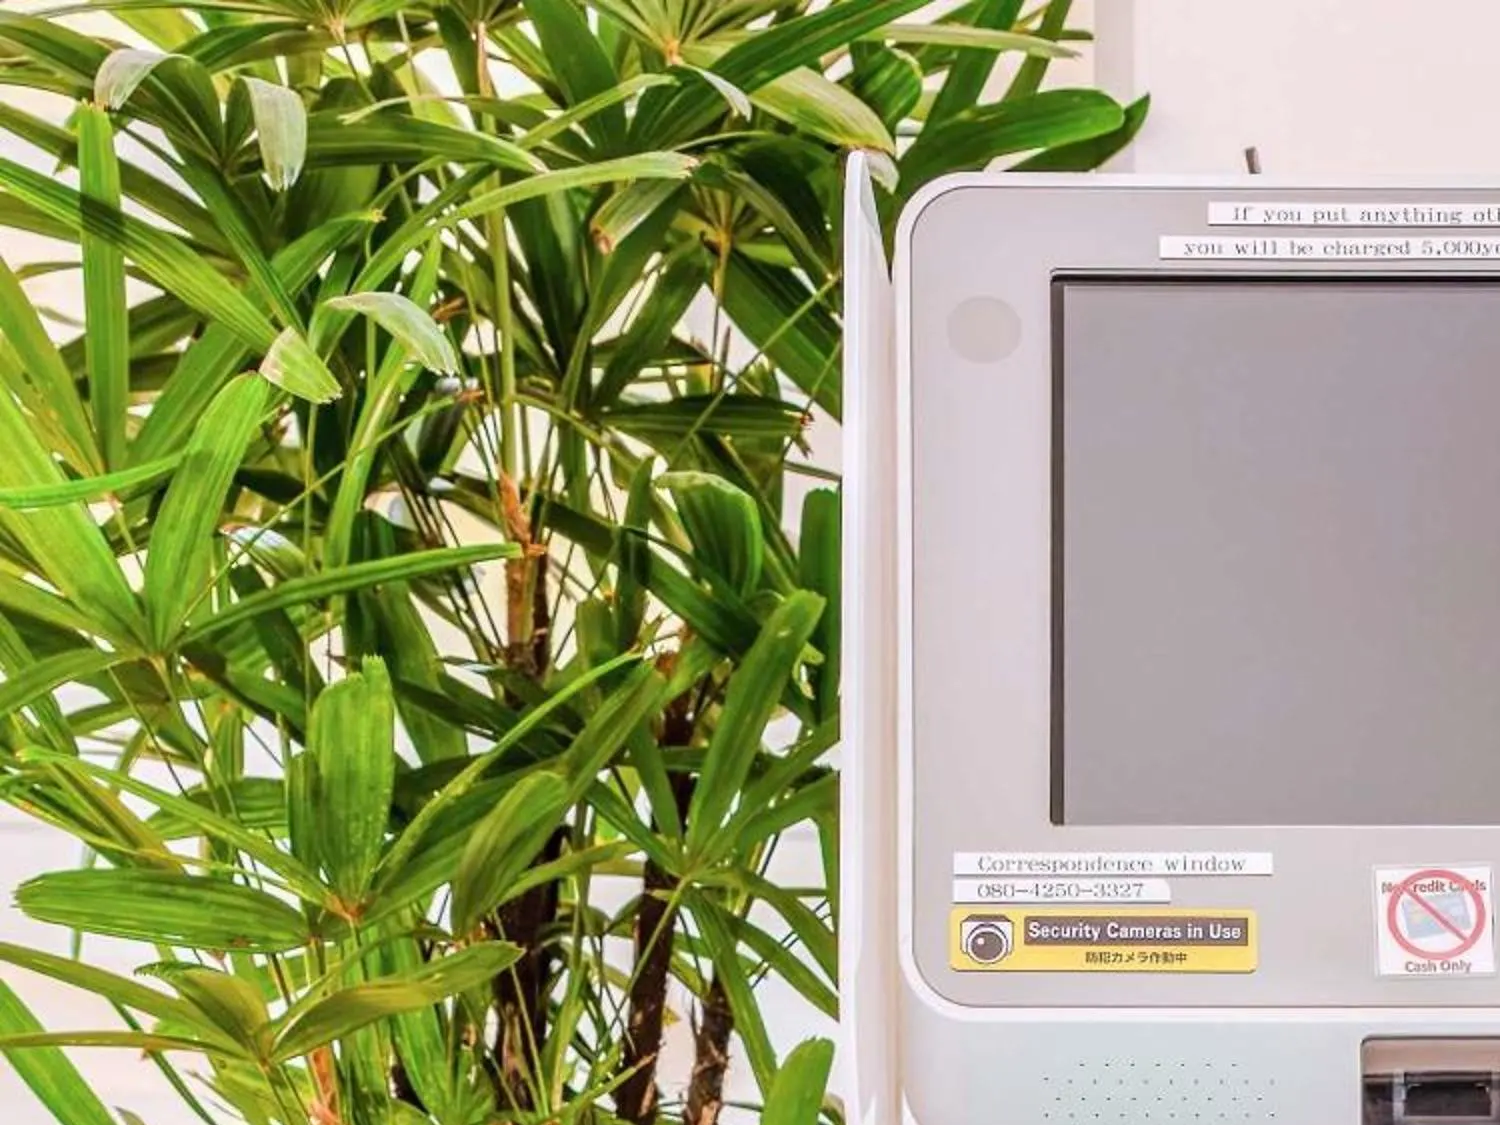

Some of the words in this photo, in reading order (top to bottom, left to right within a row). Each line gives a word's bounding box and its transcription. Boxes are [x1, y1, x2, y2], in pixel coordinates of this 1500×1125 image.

[1233, 206, 1254, 221] If
[1263, 209, 1301, 224] you
[1313, 208, 1347, 224] put
[1359, 207, 1463, 225] anything
[1184, 241, 1224, 257] you
[1235, 240, 1278, 256] will
[1290, 240, 1314, 256] be
[1323, 240, 1411, 258] charged
[977, 856, 1154, 873] Correspondence
[1163, 855, 1248, 872] window
[1028, 922, 1100, 941] Security
[1106, 922, 1182, 940] Cameras
[1187, 923, 1204, 939] in
[1209, 923, 1242, 940] Use
[1085, 951, 1188, 964] 防犯カメラ作動中
[1405, 960, 1437, 973] Cash
[1440, 960, 1472, 974] Only
